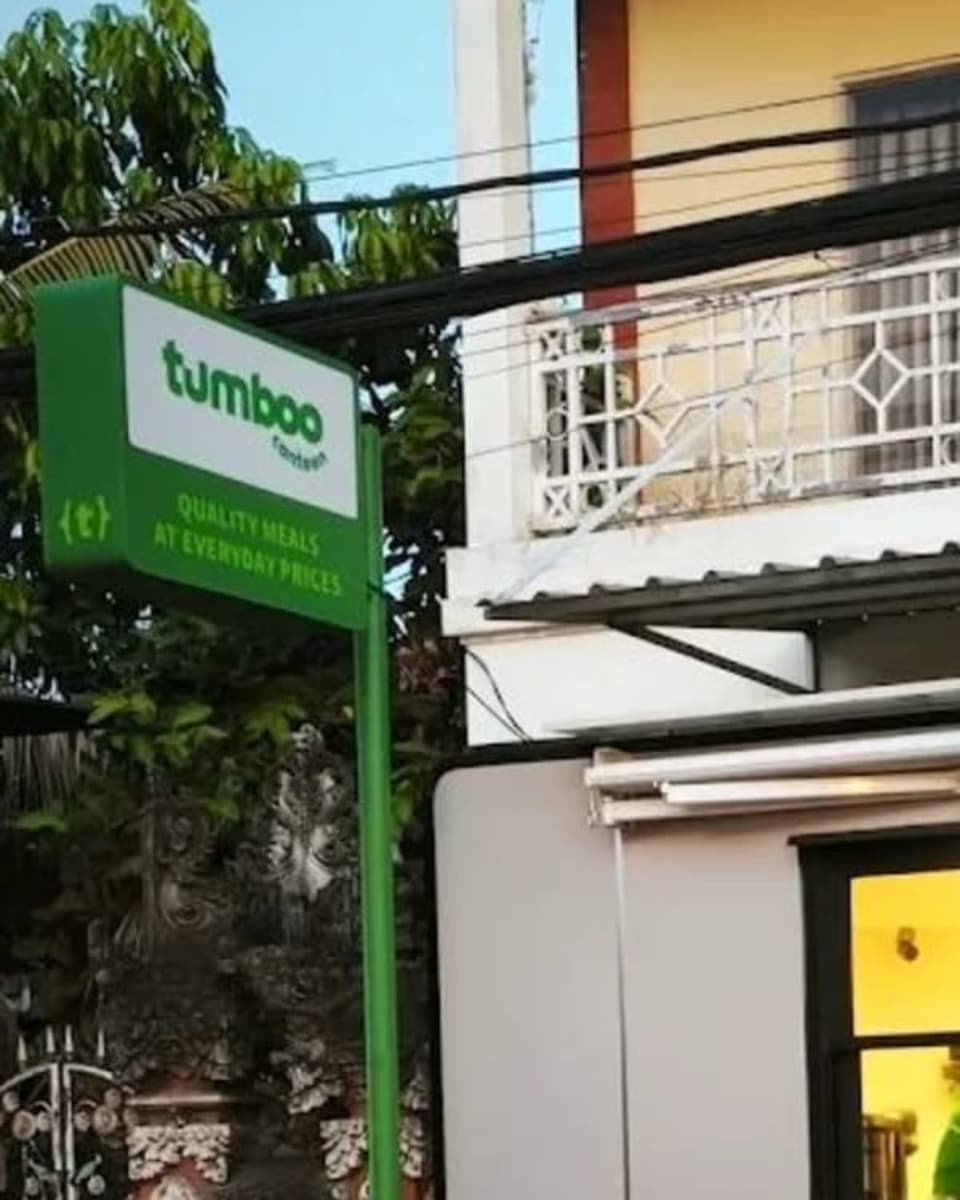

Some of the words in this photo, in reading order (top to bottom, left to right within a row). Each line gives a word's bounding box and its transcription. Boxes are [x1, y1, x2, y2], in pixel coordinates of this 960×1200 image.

[162, 340, 323, 444] tumboo
[153, 520, 176, 549] AT
[182, 529, 276, 577] EVERYDAY
[280, 558, 343, 597] PRICES
[177, 492, 259, 535] QUALITY
[262, 519, 320, 558] MEALS
